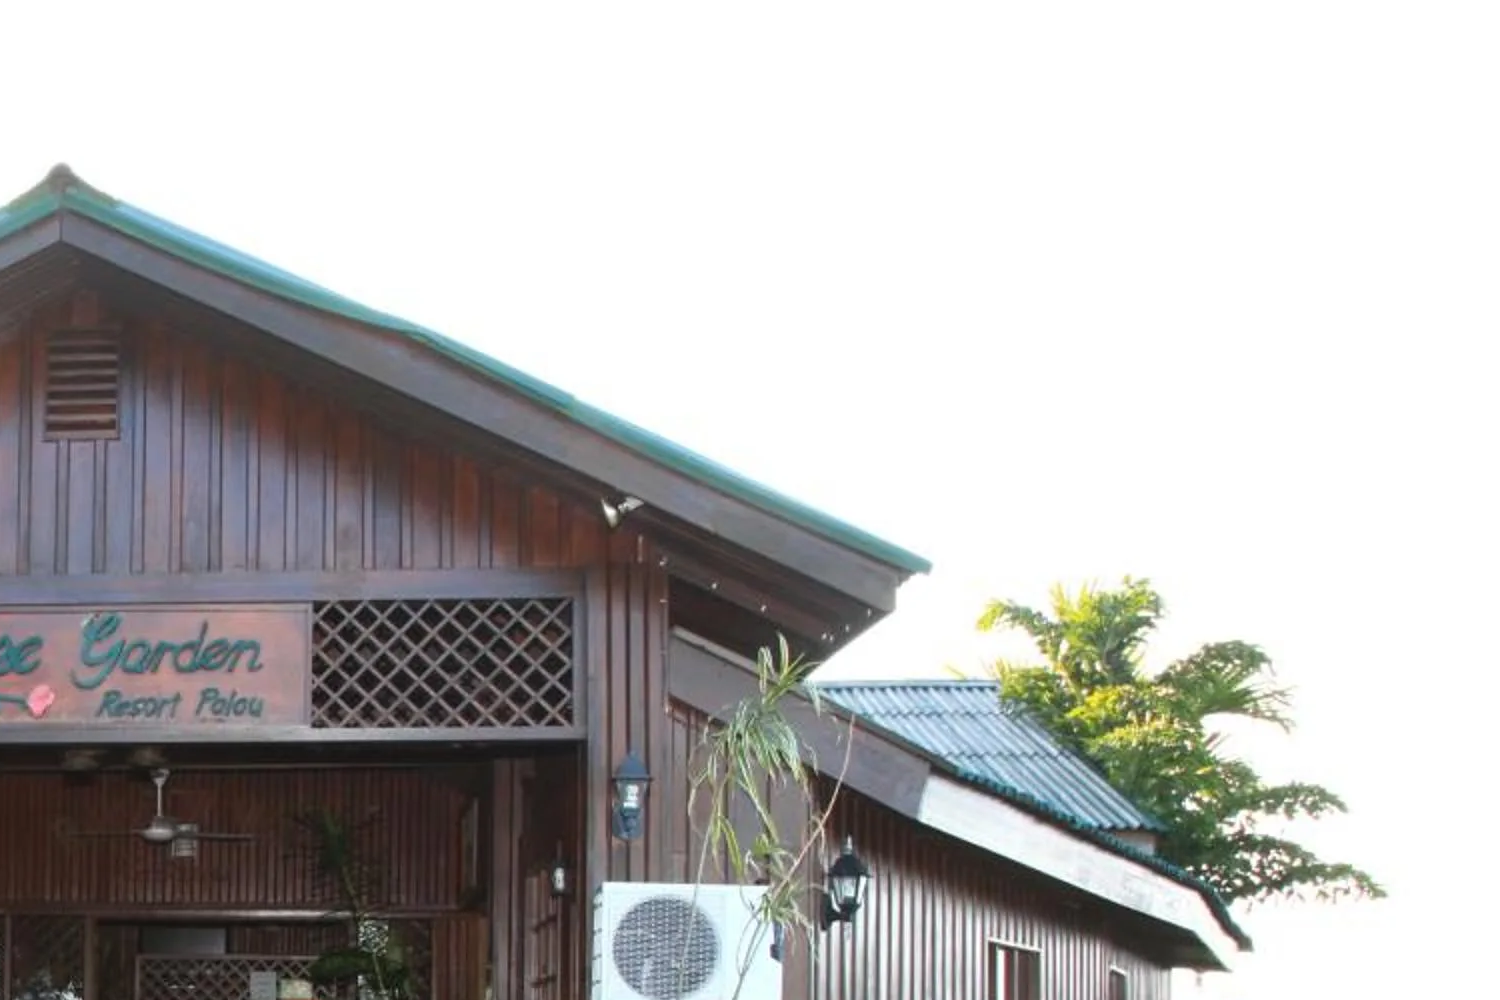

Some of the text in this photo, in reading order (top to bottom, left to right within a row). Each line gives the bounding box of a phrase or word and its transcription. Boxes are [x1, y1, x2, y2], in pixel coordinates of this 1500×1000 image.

[70, 611, 264, 690] Garden
[95, 687, 264, 718] Resort Palau
